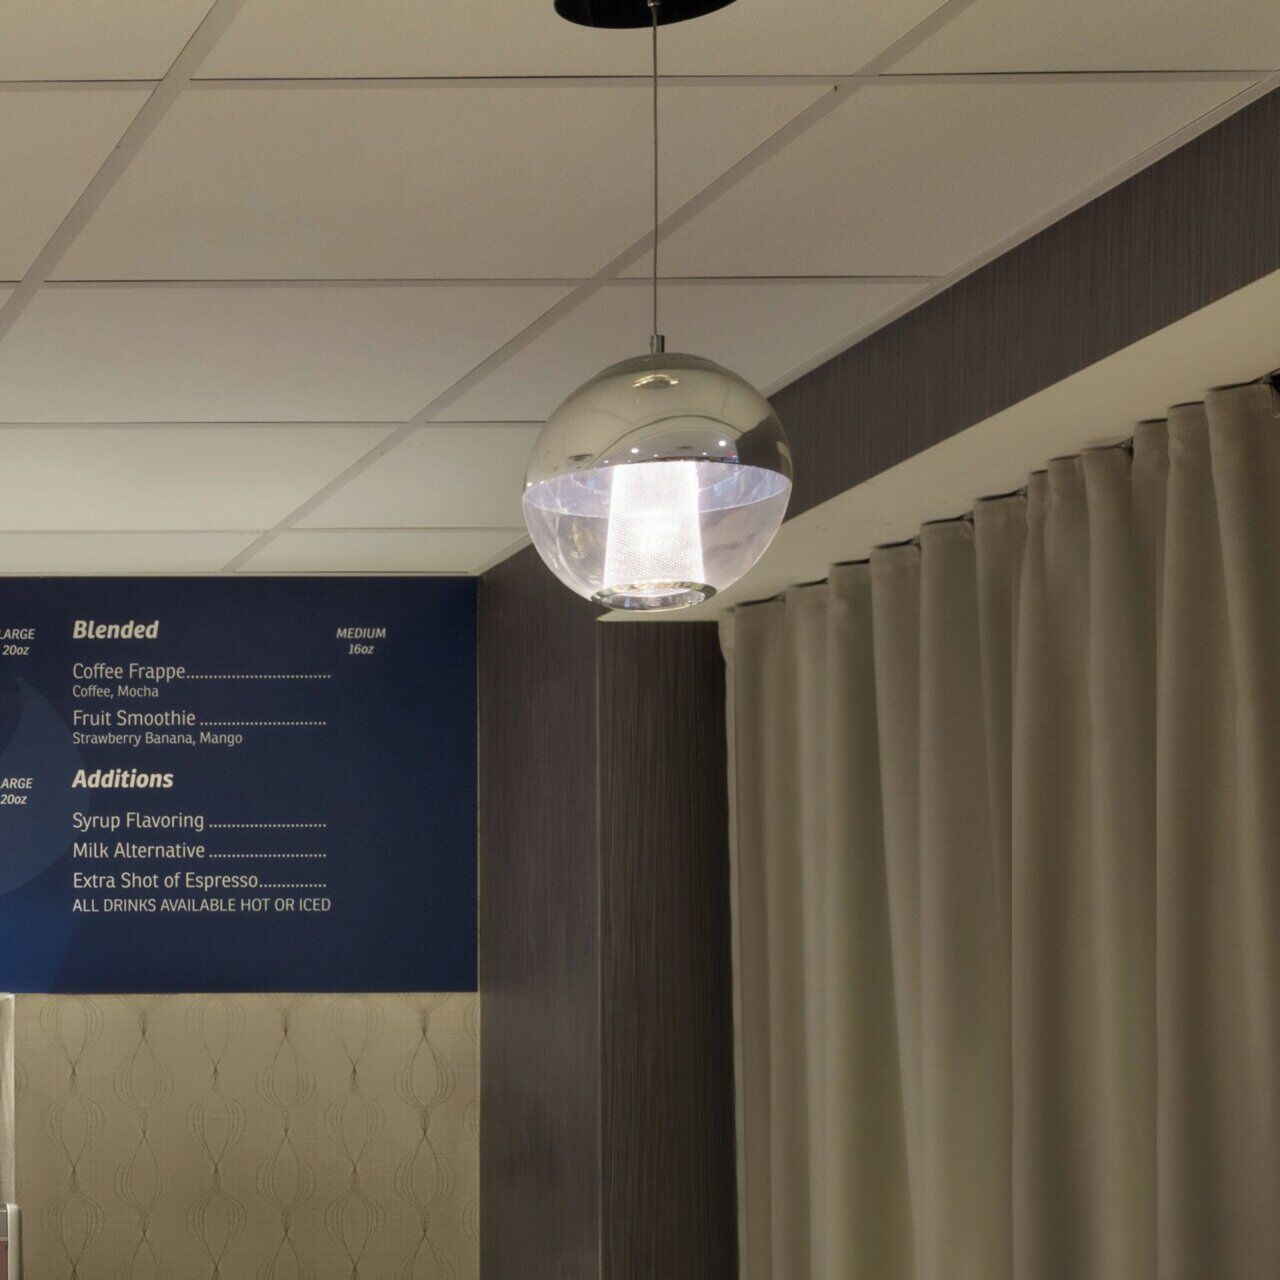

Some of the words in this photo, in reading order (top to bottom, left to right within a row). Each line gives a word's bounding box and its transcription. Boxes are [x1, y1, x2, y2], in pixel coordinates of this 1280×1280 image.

[72, 620, 159, 639] Blended
[336, 628, 386, 639] MEDIUM
[2, 645, 29, 656] 20oz
[348, 644, 374, 655] 16oz
[72, 663, 124, 680] Coffee
[130, 663, 185, 683] Frappe
[72, 685, 114, 698] Coffee,
[118, 685, 159, 697] Mocha
[73, 710, 112, 726] Fruit
[117, 710, 196, 726] Smoothie
[72, 732, 141, 747] Strawberry
[145, 732, 196, 747] Banana,
[200, 732, 243, 747] Mango
[71, 768, 174, 789] Additions
[0, 794, 27, 805] 20oz
[73, 812, 120, 832] Syrup
[127, 812, 205, 832] Flavoring
[73, 842, 109, 858] Milk
[114, 842, 205, 858] Alternative
[73, 872, 116, 889] Extra
[121, 872, 159, 889] Shot
[164, 872, 181, 889] of
[186, 872, 258, 891] Espresso
[72, 899, 99, 912] ALL
[104, 898, 156, 912] DRINKS
[160, 898, 236, 912] AVAILABLE
[241, 898, 270, 912] HOT
[274, 898, 295, 912] OR
[300, 898, 331, 912] ICED
